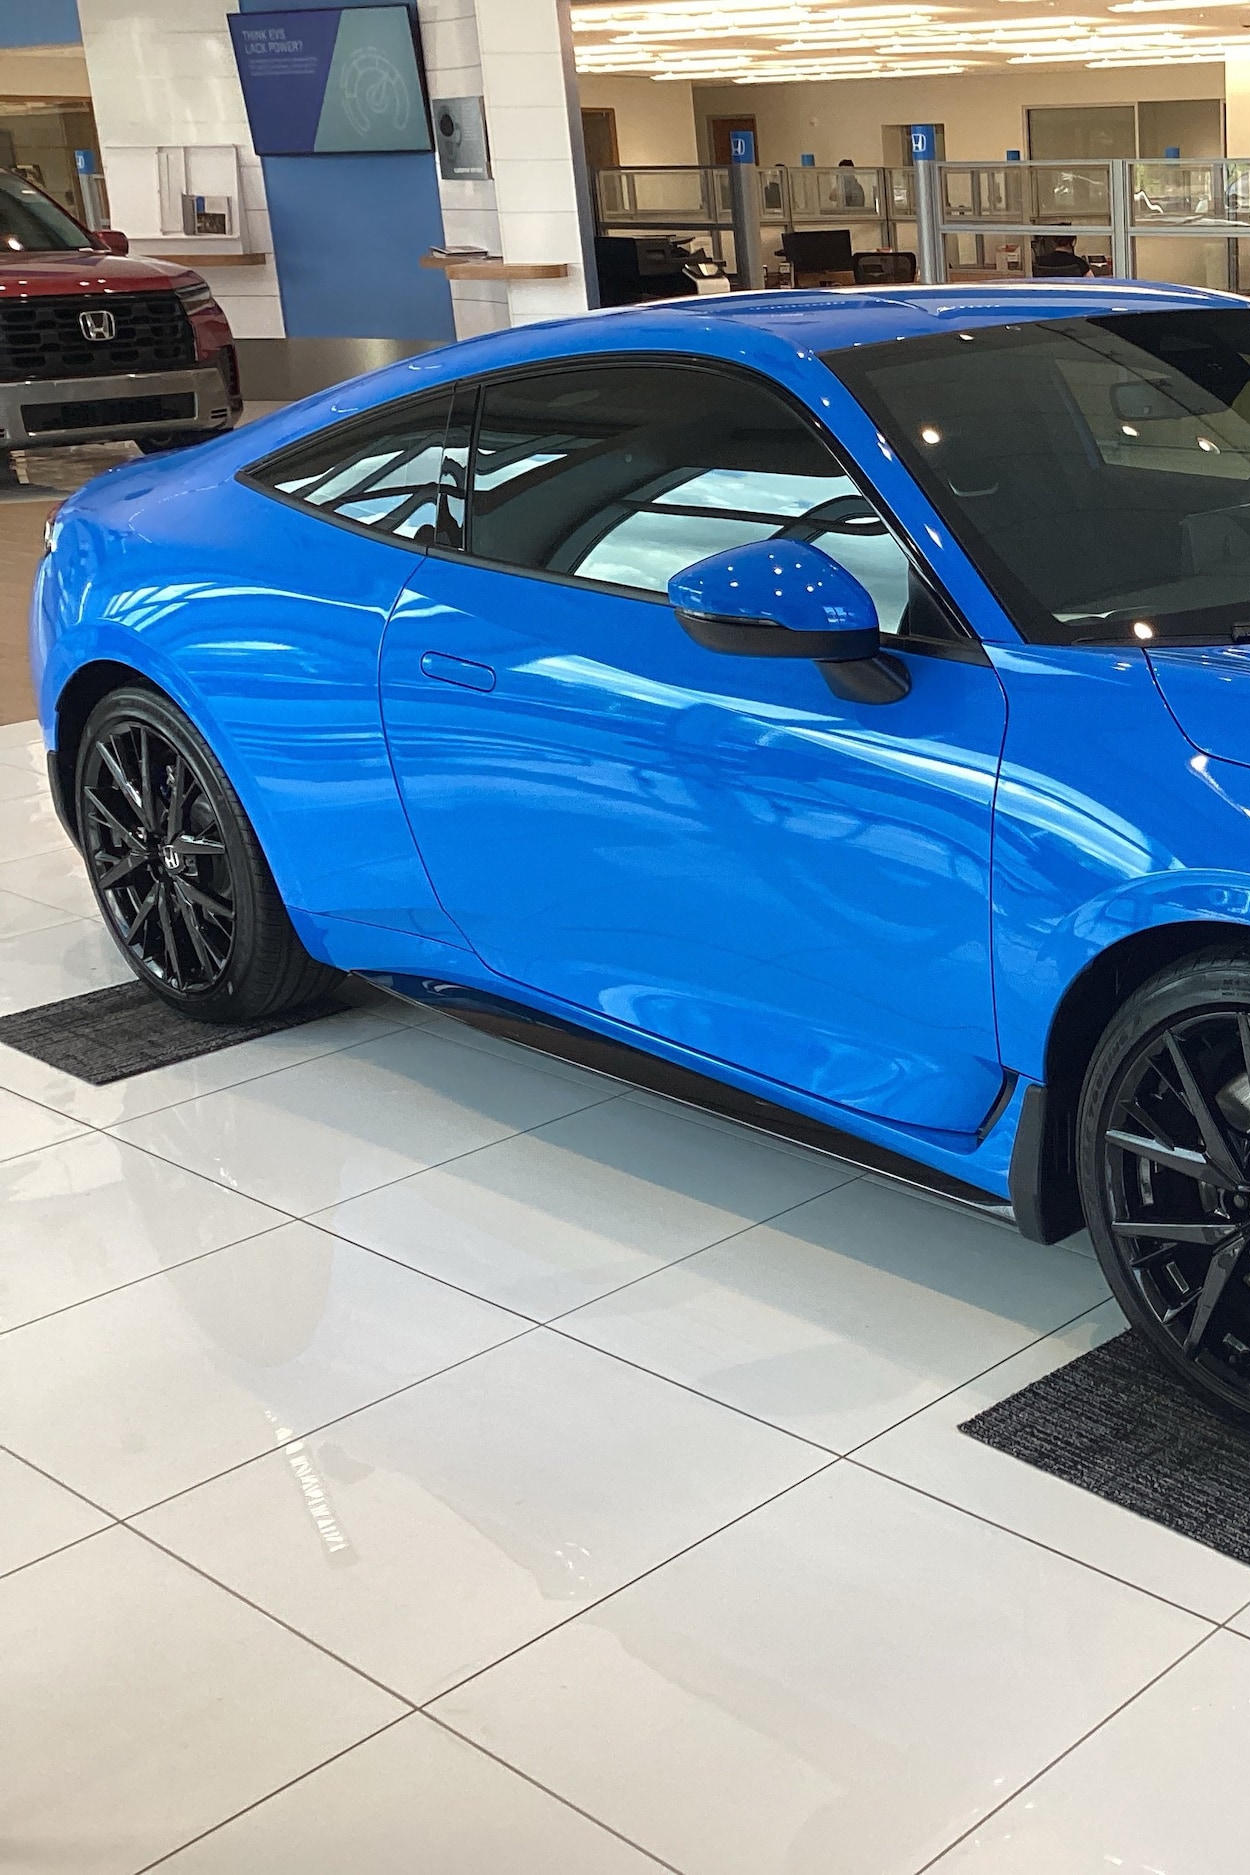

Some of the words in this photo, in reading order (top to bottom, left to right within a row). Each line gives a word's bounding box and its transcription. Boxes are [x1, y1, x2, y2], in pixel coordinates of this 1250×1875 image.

[241, 30, 267, 41] THINK
[244, 42, 267, 55] LACK
[267, 40, 304, 53] POWER?
